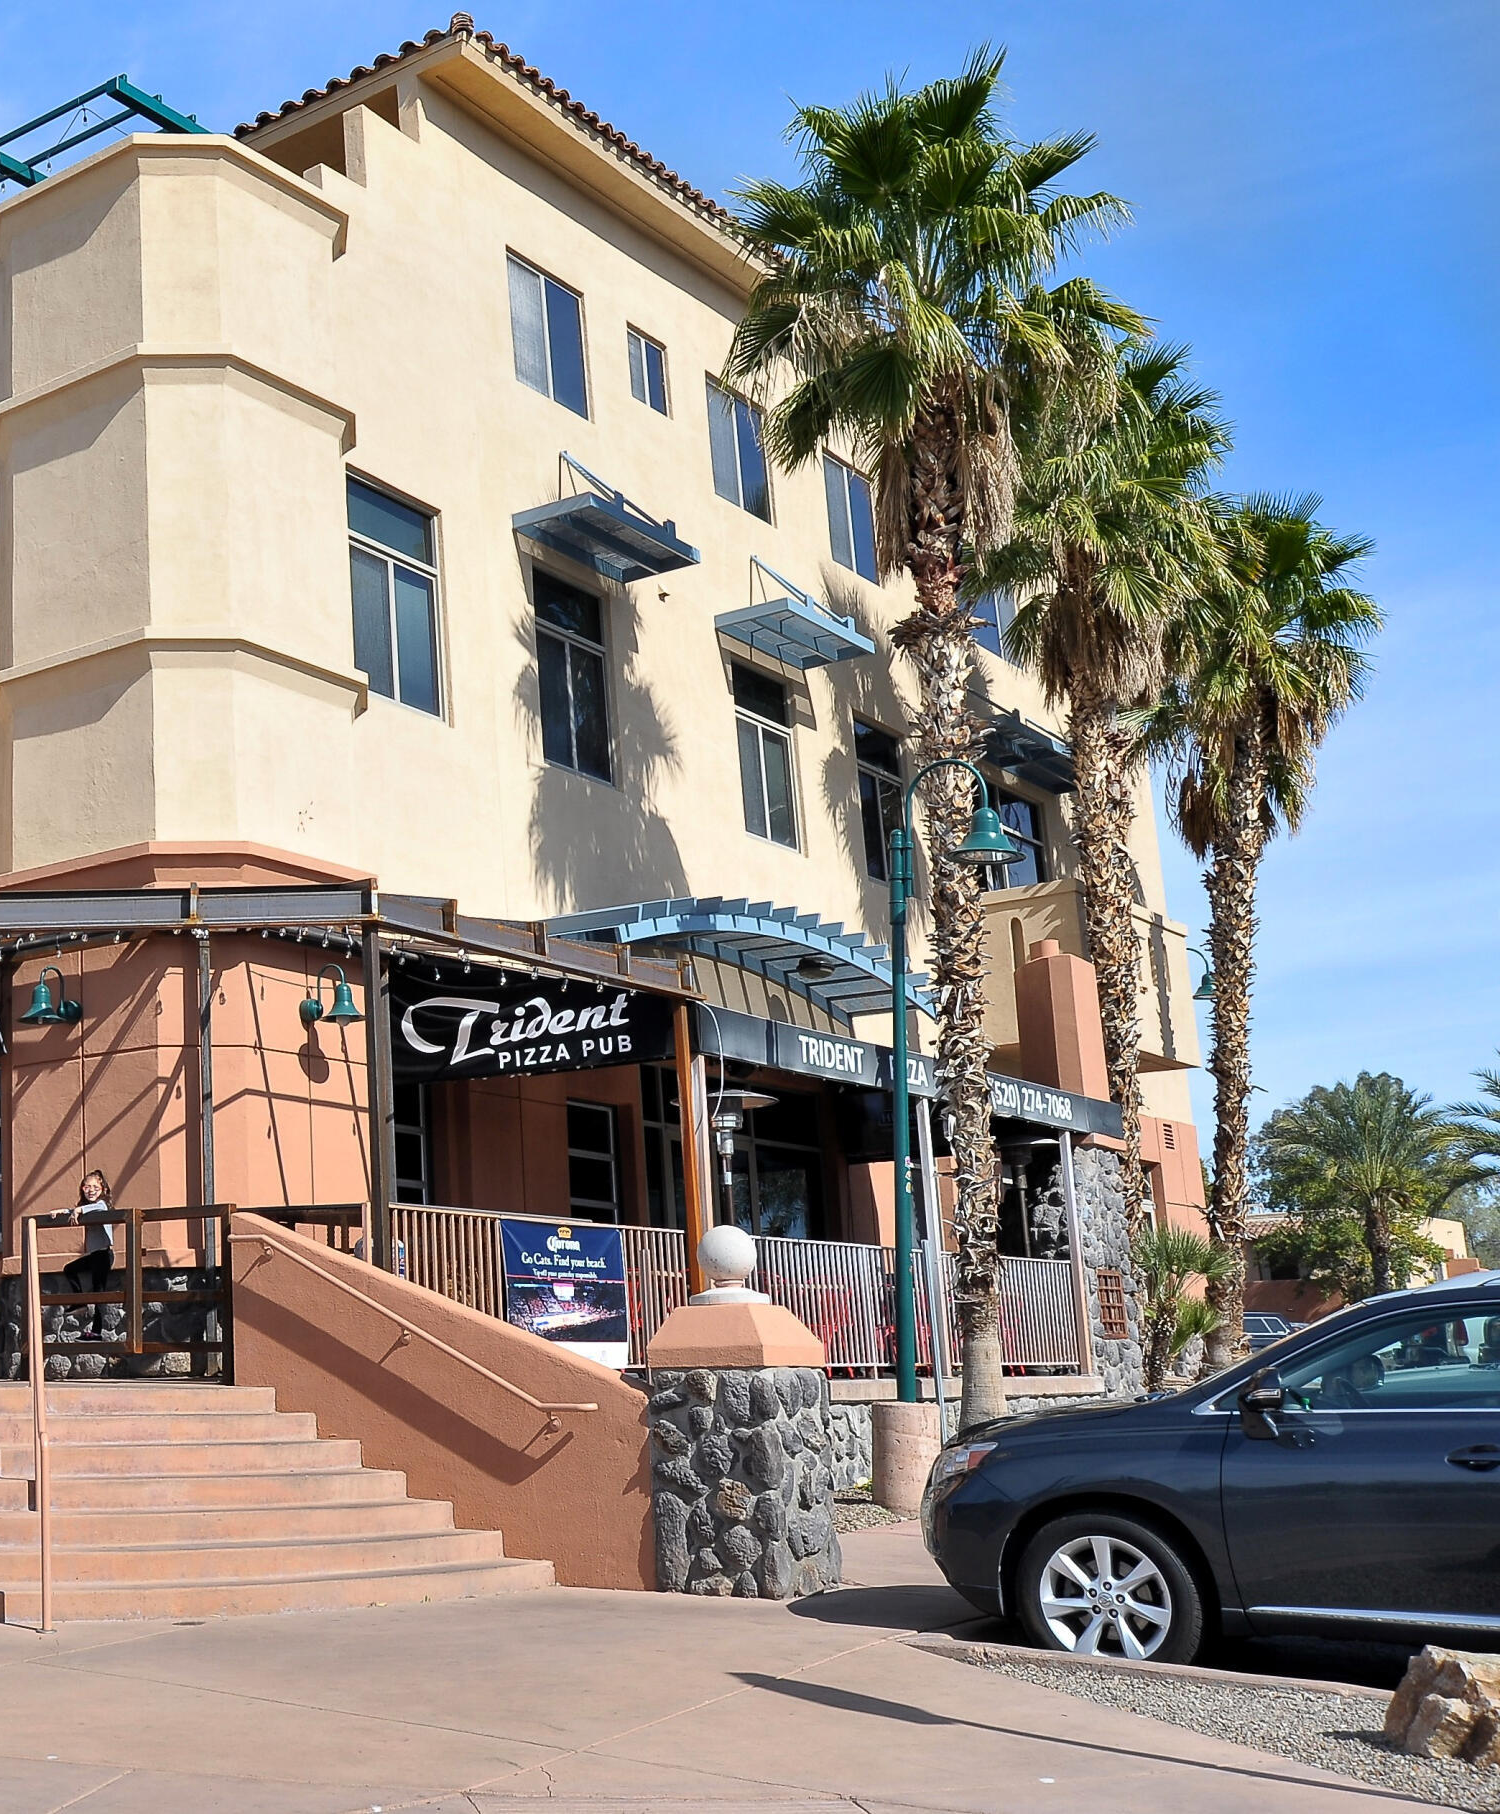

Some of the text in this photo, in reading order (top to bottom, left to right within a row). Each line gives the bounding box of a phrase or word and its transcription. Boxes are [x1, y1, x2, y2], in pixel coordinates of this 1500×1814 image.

[401, 993, 630, 1065] Trident
[499, 1035, 633, 1070] PIZZA PUB
[798, 1034, 864, 1075] TRIDENT
[1021, 1087, 1073, 1120] 274-7068
[521, 1251, 533, 1264] Go
[533, 1252, 553, 1266] Cats.
[553, 1254, 570, 1267] Find
[570, 1259, 585, 1270] your
[546, 1236, 581, 1253] Corona
